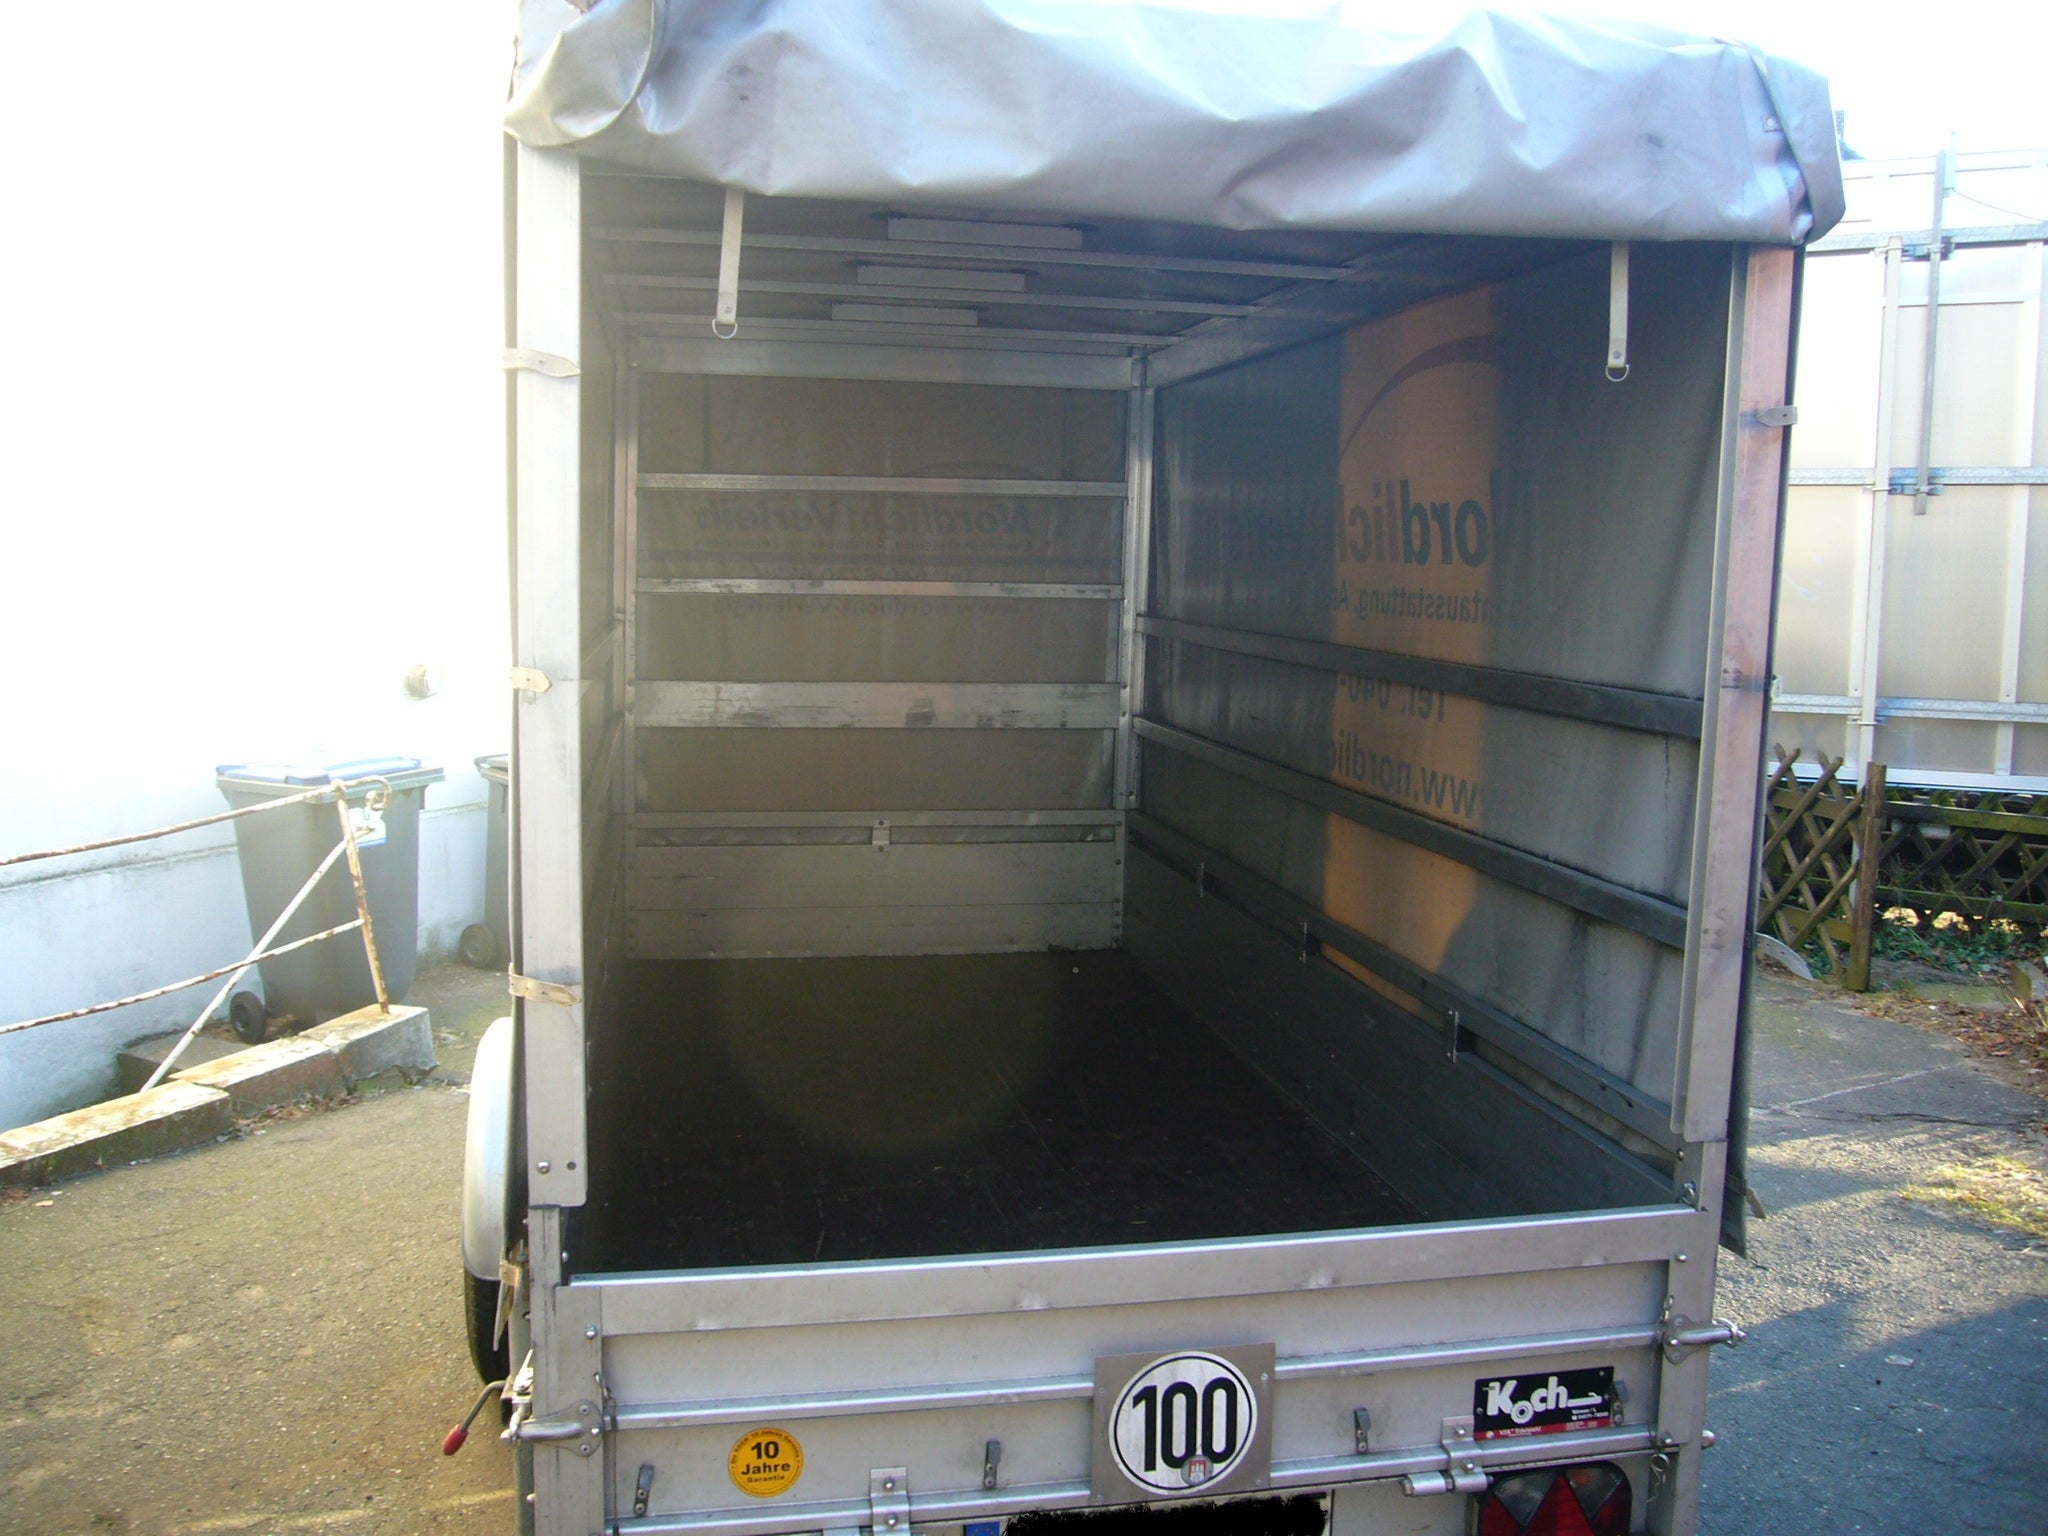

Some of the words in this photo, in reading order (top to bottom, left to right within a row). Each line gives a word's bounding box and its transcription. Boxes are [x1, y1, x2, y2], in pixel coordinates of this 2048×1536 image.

[1486, 1375, 1568, 1424] Koch
[1132, 1376, 1238, 1472] 100
[751, 1440, 779, 1460] 10
[741, 1462, 791, 1475] Jahre
[746, 1474, 785, 1483] Garantie
